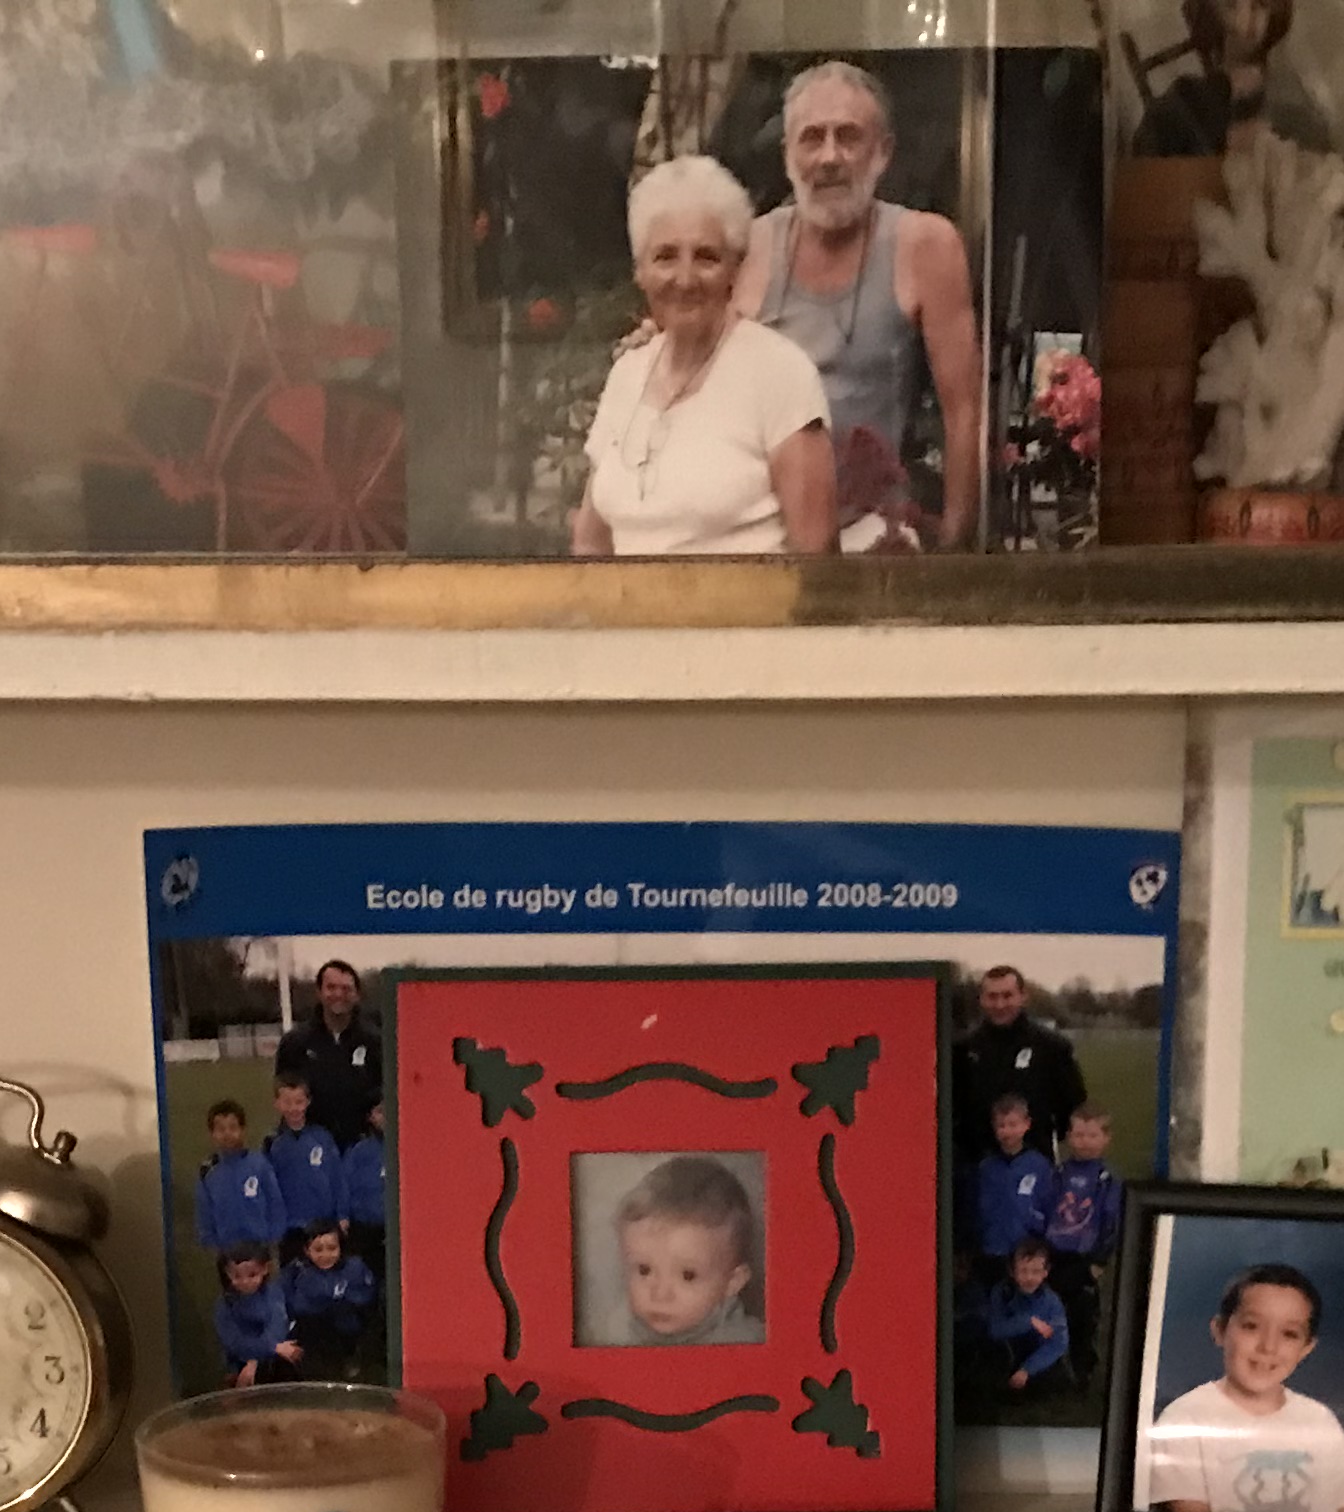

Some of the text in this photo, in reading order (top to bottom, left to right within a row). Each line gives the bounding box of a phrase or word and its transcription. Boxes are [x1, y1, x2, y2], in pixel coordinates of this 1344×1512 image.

[366, 882, 958, 914] Ecole de rugby de Tournefeuille 2008-2009
[24, 1300, 46, 1331] 2
[43, 1355, 66, 1386] 3
[29, 1407, 50, 1439] 4
